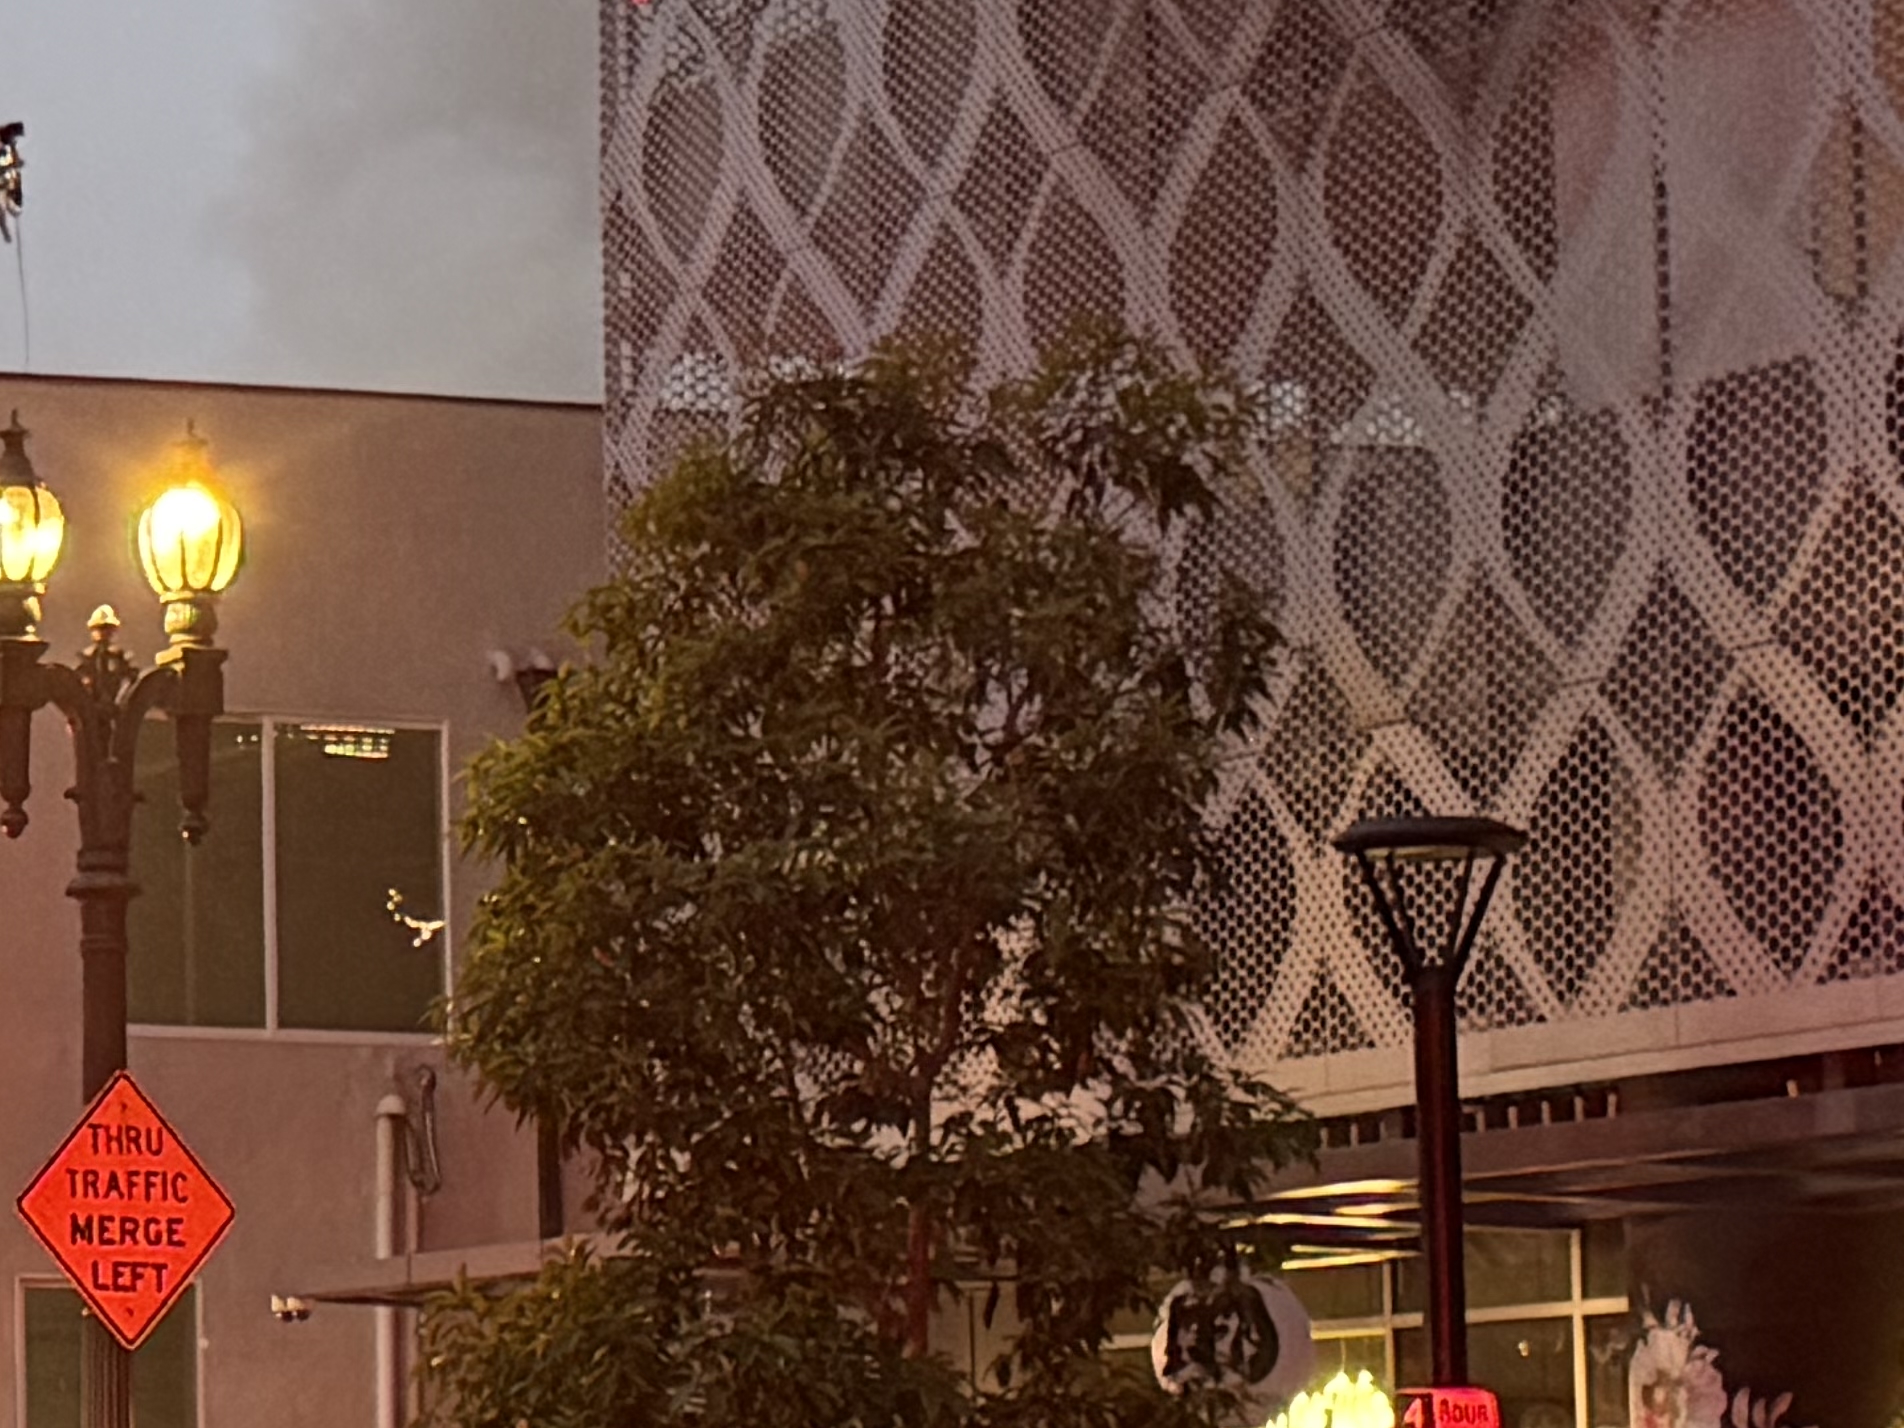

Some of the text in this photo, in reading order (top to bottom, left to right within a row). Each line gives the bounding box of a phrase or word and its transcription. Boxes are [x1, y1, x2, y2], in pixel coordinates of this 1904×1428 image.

[86, 1122, 164, 1157] THRU
[64, 1167, 190, 1205] TRAFFIC
[69, 1211, 187, 1248] MERGE
[90, 1259, 169, 1295] LEFT
[1438, 1397, 1490, 1425] HOUR
